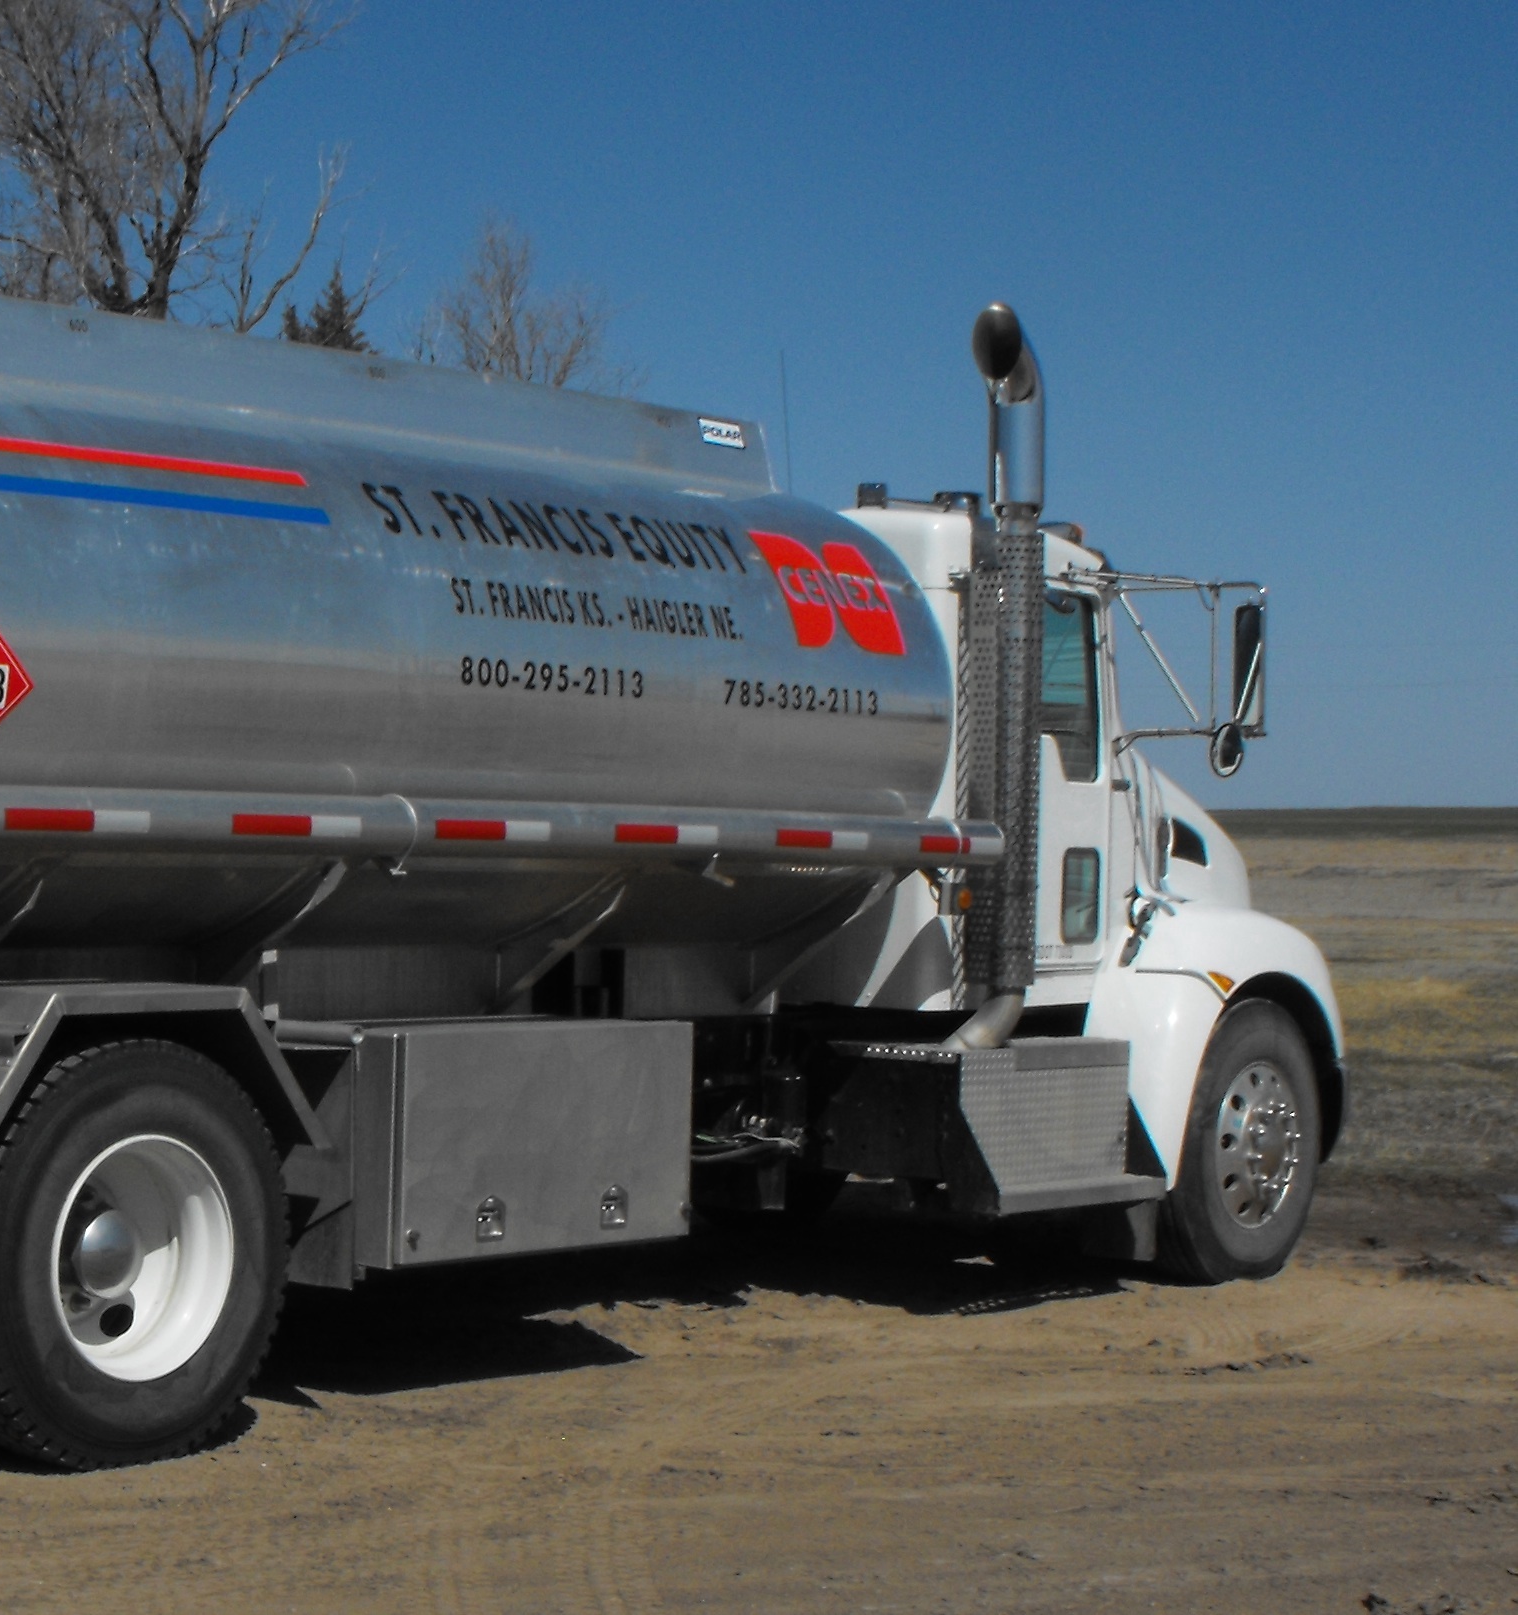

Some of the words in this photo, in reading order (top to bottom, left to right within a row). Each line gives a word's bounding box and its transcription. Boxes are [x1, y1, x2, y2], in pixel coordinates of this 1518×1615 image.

[702, 425, 741, 439] POLAR
[361, 482, 441, 539] ST.
[431, 490, 614, 558] FRANCIS
[604, 512, 747, 574] EQUITY
[450, 576, 484, 615] ST.
[486, 580, 576, 624] FRANCIS
[577, 591, 613, 628] KS.
[625, 596, 709, 638] HAIGLER
[709, 604, 743, 640] NE.
[777, 565, 889, 612] CENEX
[460, 655, 644, 699] 800-295-2113
[723, 678, 878, 716] 785-332-2113
